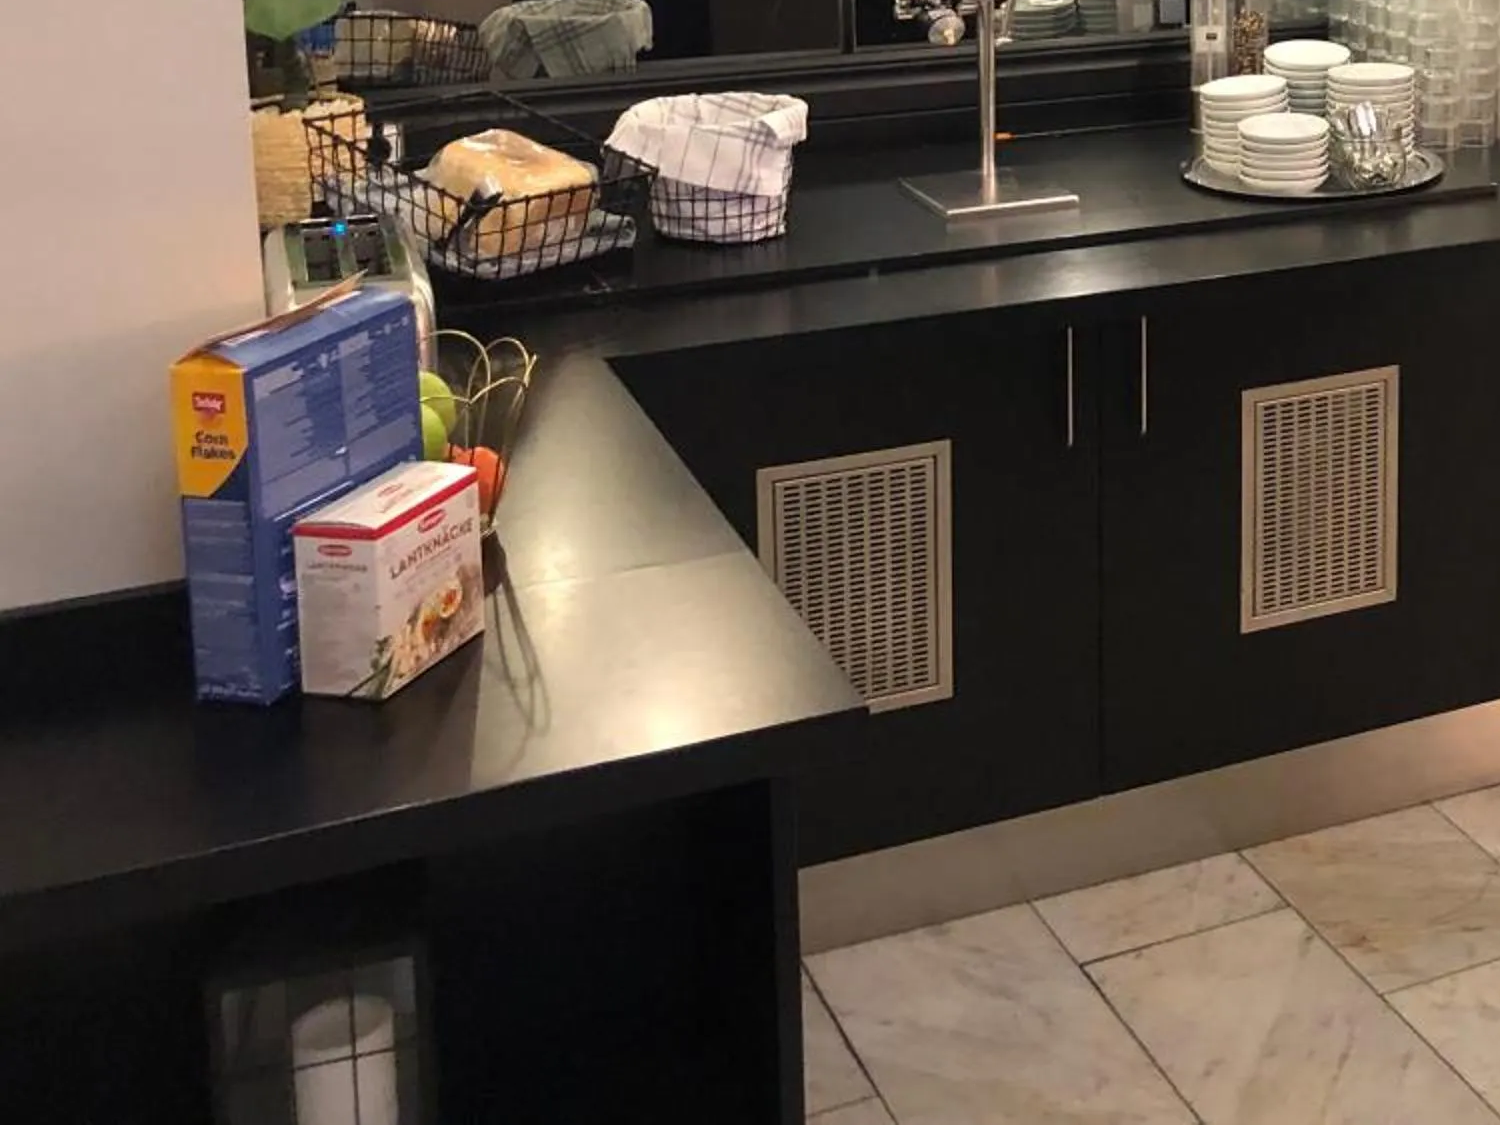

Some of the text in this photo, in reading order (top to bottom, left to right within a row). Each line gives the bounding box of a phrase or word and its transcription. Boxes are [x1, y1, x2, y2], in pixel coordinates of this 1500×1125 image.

[195, 430, 229, 445] Corn
[191, 446, 236, 460] Flakes
[390, 517, 474, 580] LANTKNÄCKE
